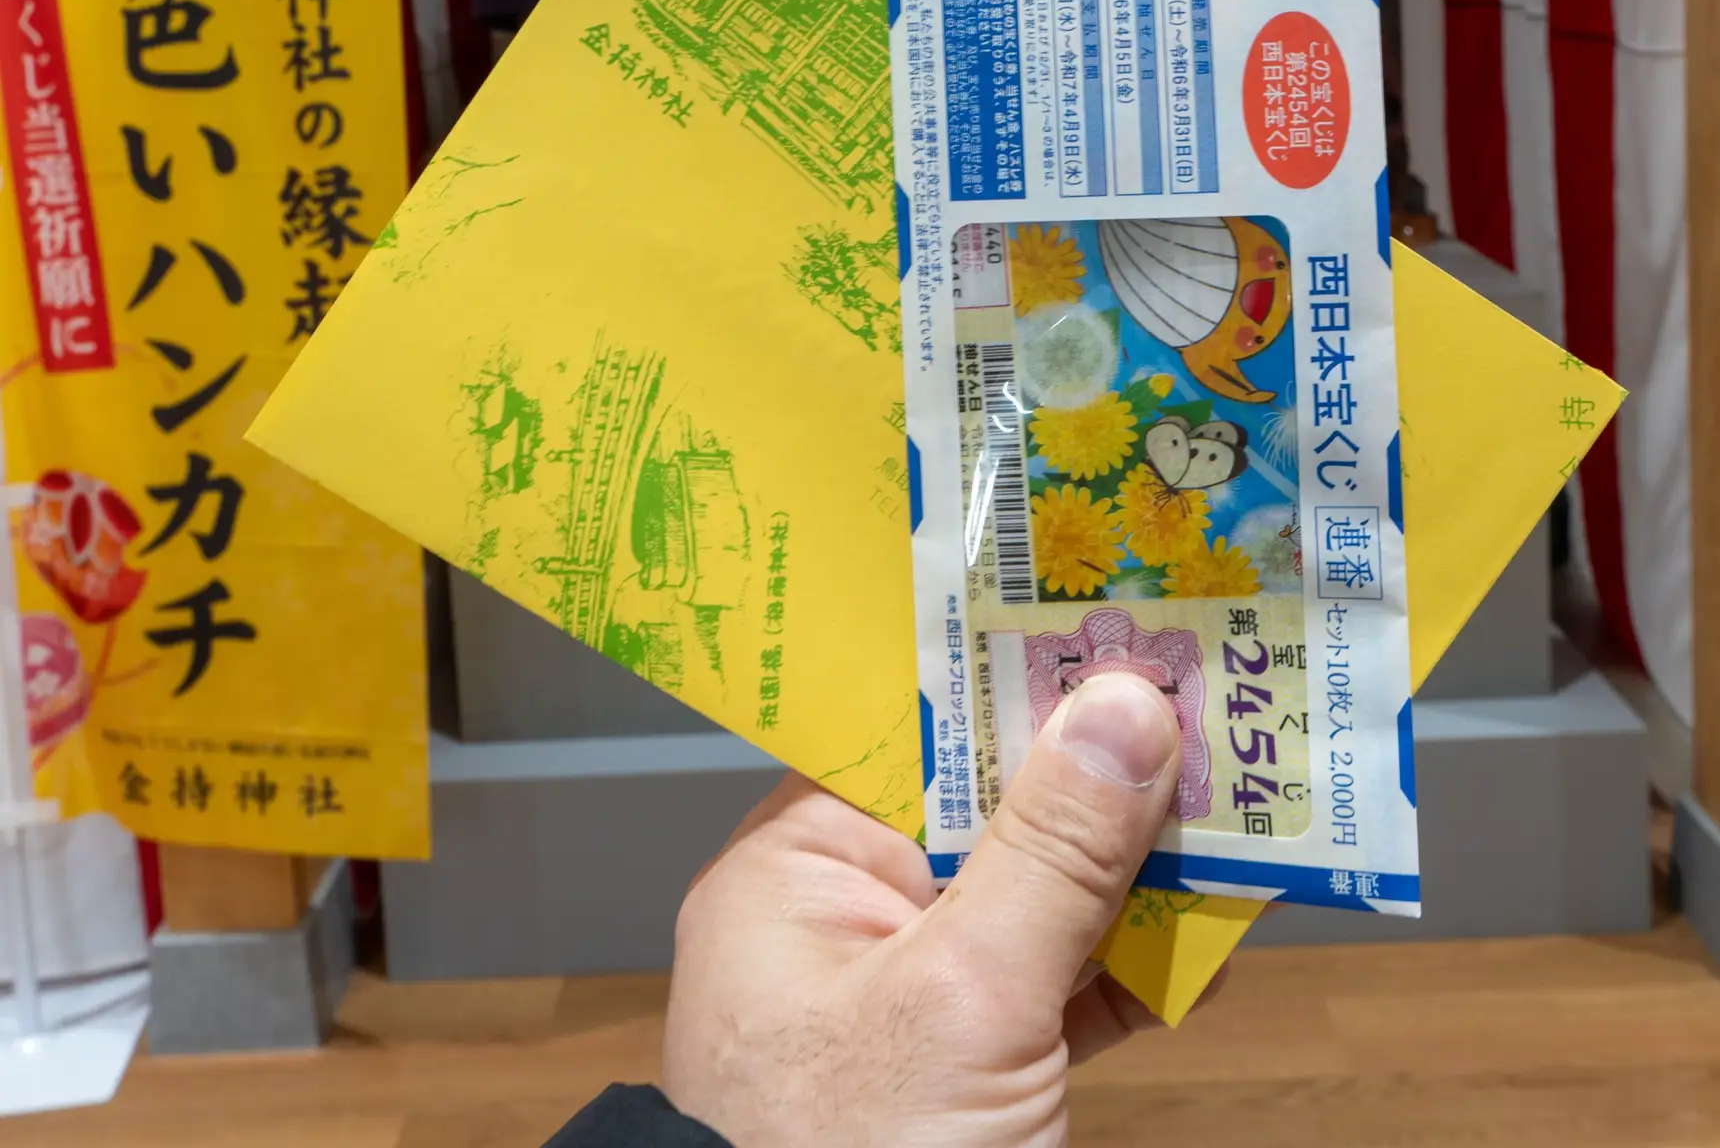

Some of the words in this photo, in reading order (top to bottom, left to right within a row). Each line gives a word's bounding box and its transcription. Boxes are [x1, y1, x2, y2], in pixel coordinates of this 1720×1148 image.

[580, 23, 694, 128] 金持神社
[1261, 41, 1286, 161] 西日本宝くじ
[1286, 52, 1310, 148] 第2454回
[1311, 41, 1335, 157] この宝くじは
[965, 343, 983, 412] 抽せん日
[1307, 254, 1357, 491] 西日本宝くじ
[1325, 516, 1373, 589] 連番
[1325, 602, 1352, 740] セット10枚入
[947, 619, 971, 830] 西日本ブロック17県5指定都市
[1222, 608, 1279, 836] 第2454回
[118, 764, 345, 815] 金持神社
[938, 748, 954, 830] みずほ銀行
[1329, 751, 1358, 846] 2,000円
[1329, 870, 1379, 897] 連番
